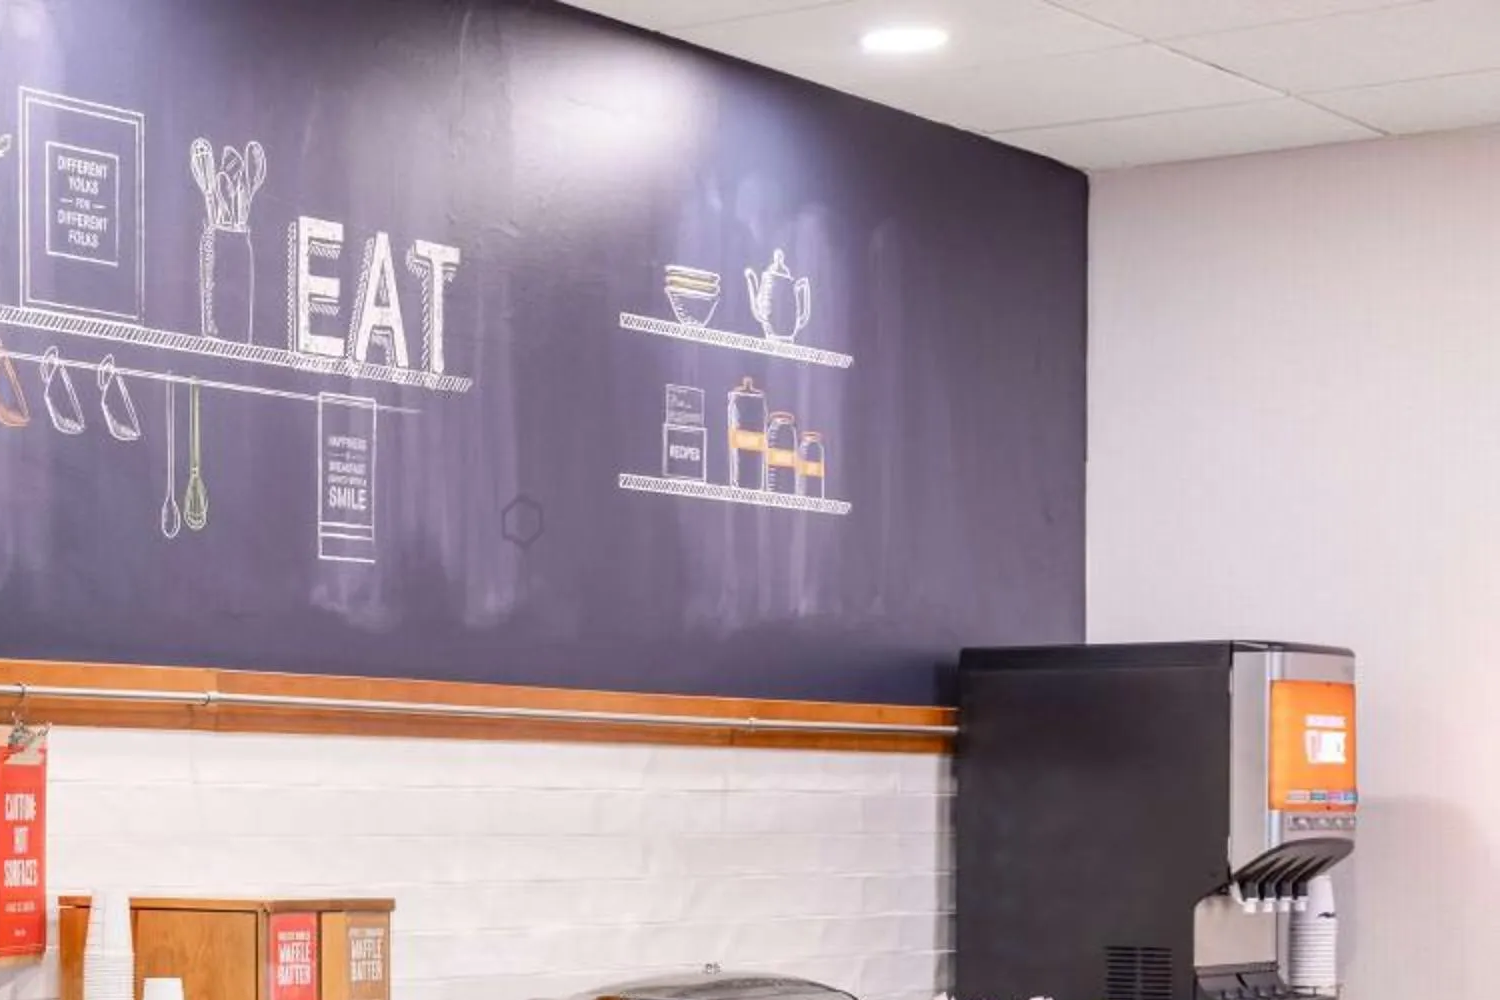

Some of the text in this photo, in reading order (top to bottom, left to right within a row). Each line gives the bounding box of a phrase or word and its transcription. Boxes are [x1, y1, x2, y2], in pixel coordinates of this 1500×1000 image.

[57, 155, 108, 180] DIFFERENT
[68, 176, 99, 195] YOLKS
[57, 208, 108, 233] DIFFERENT
[67, 228, 100, 249] FOLKS
[288, 216, 461, 373] EAT
[329, 486, 367, 511] SMILE
[277, 940, 311, 963] WAFFLE
[350, 937, 383, 960] WAFFLE
[277, 963, 311, 986] BATTER
[350, 960, 384, 982] BATTER
